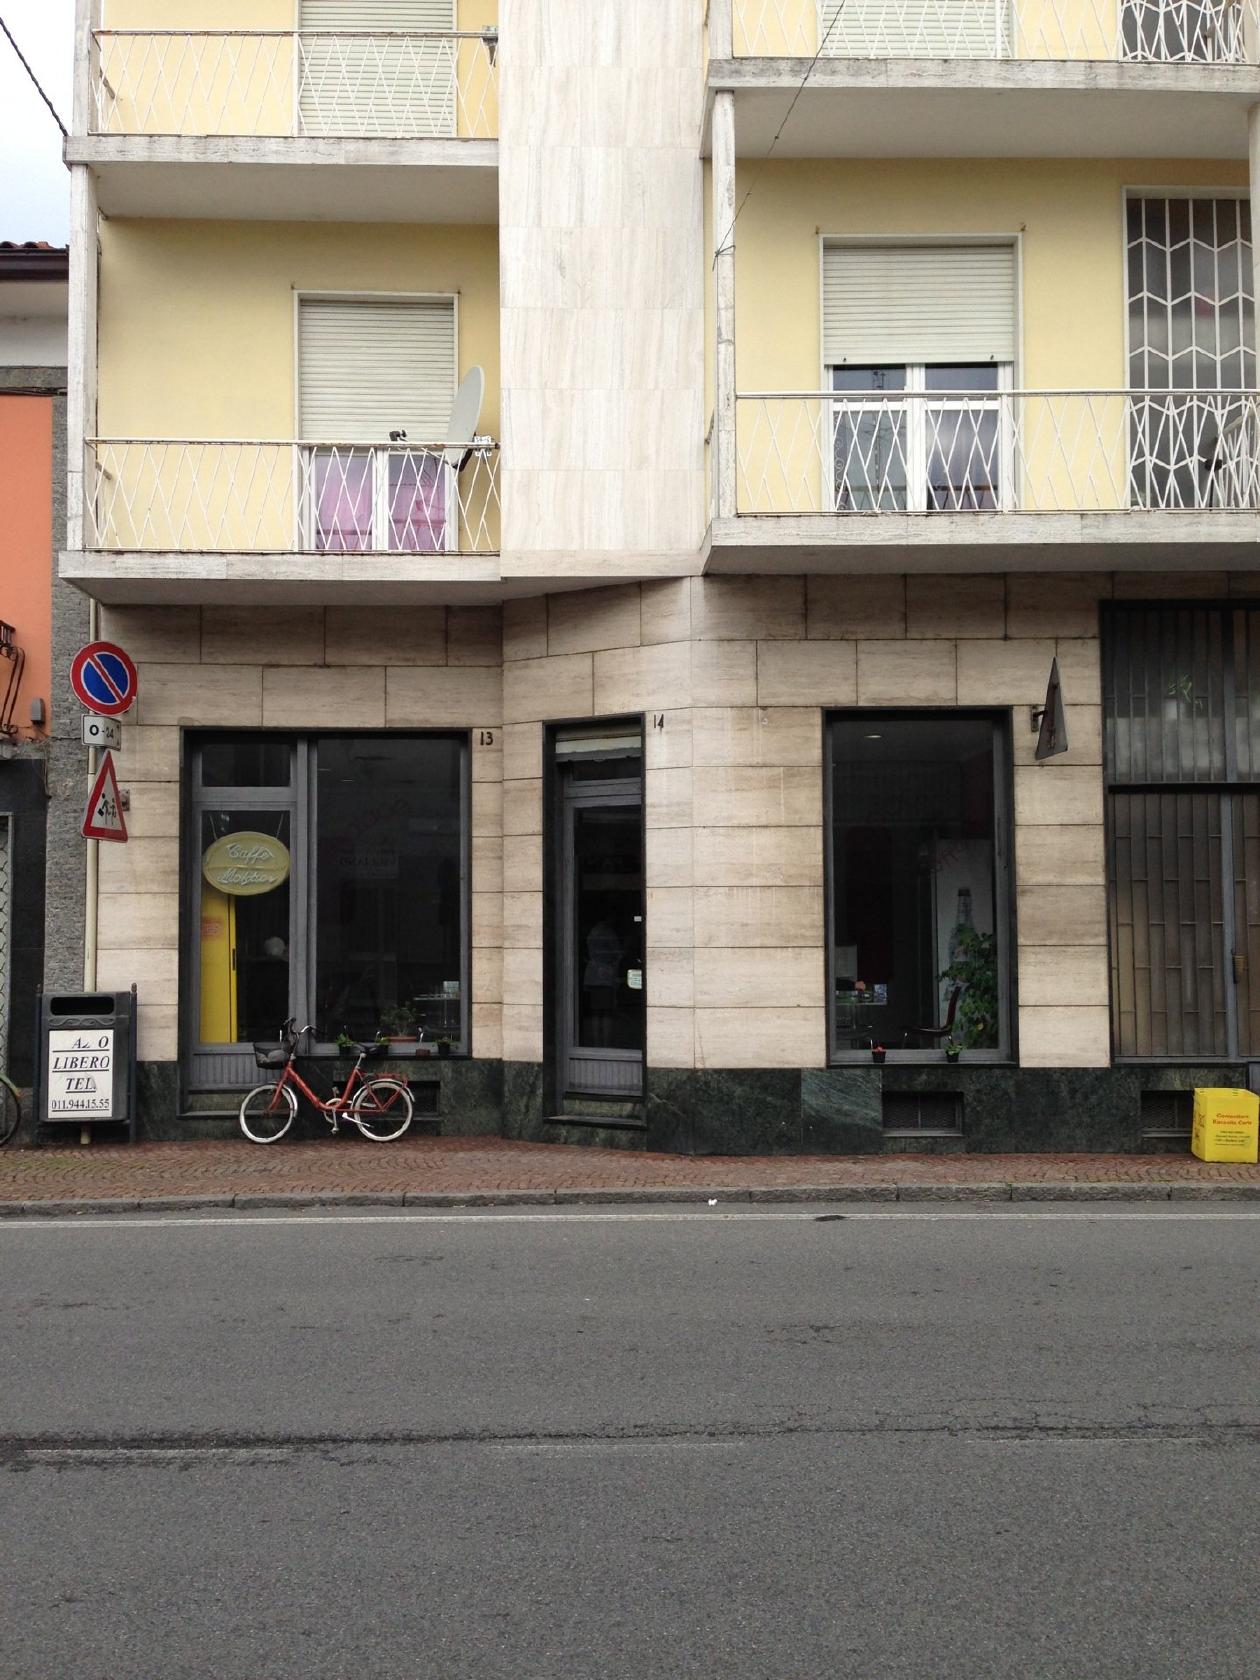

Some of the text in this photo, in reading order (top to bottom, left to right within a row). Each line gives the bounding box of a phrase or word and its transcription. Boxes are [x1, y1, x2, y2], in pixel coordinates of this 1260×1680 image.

[653, 713, 666, 729] 14
[480, 731, 494, 746] 13
[53, 1055, 110, 1070] LIBERO
[51, 1098, 110, 1110] 011.944.15.55
